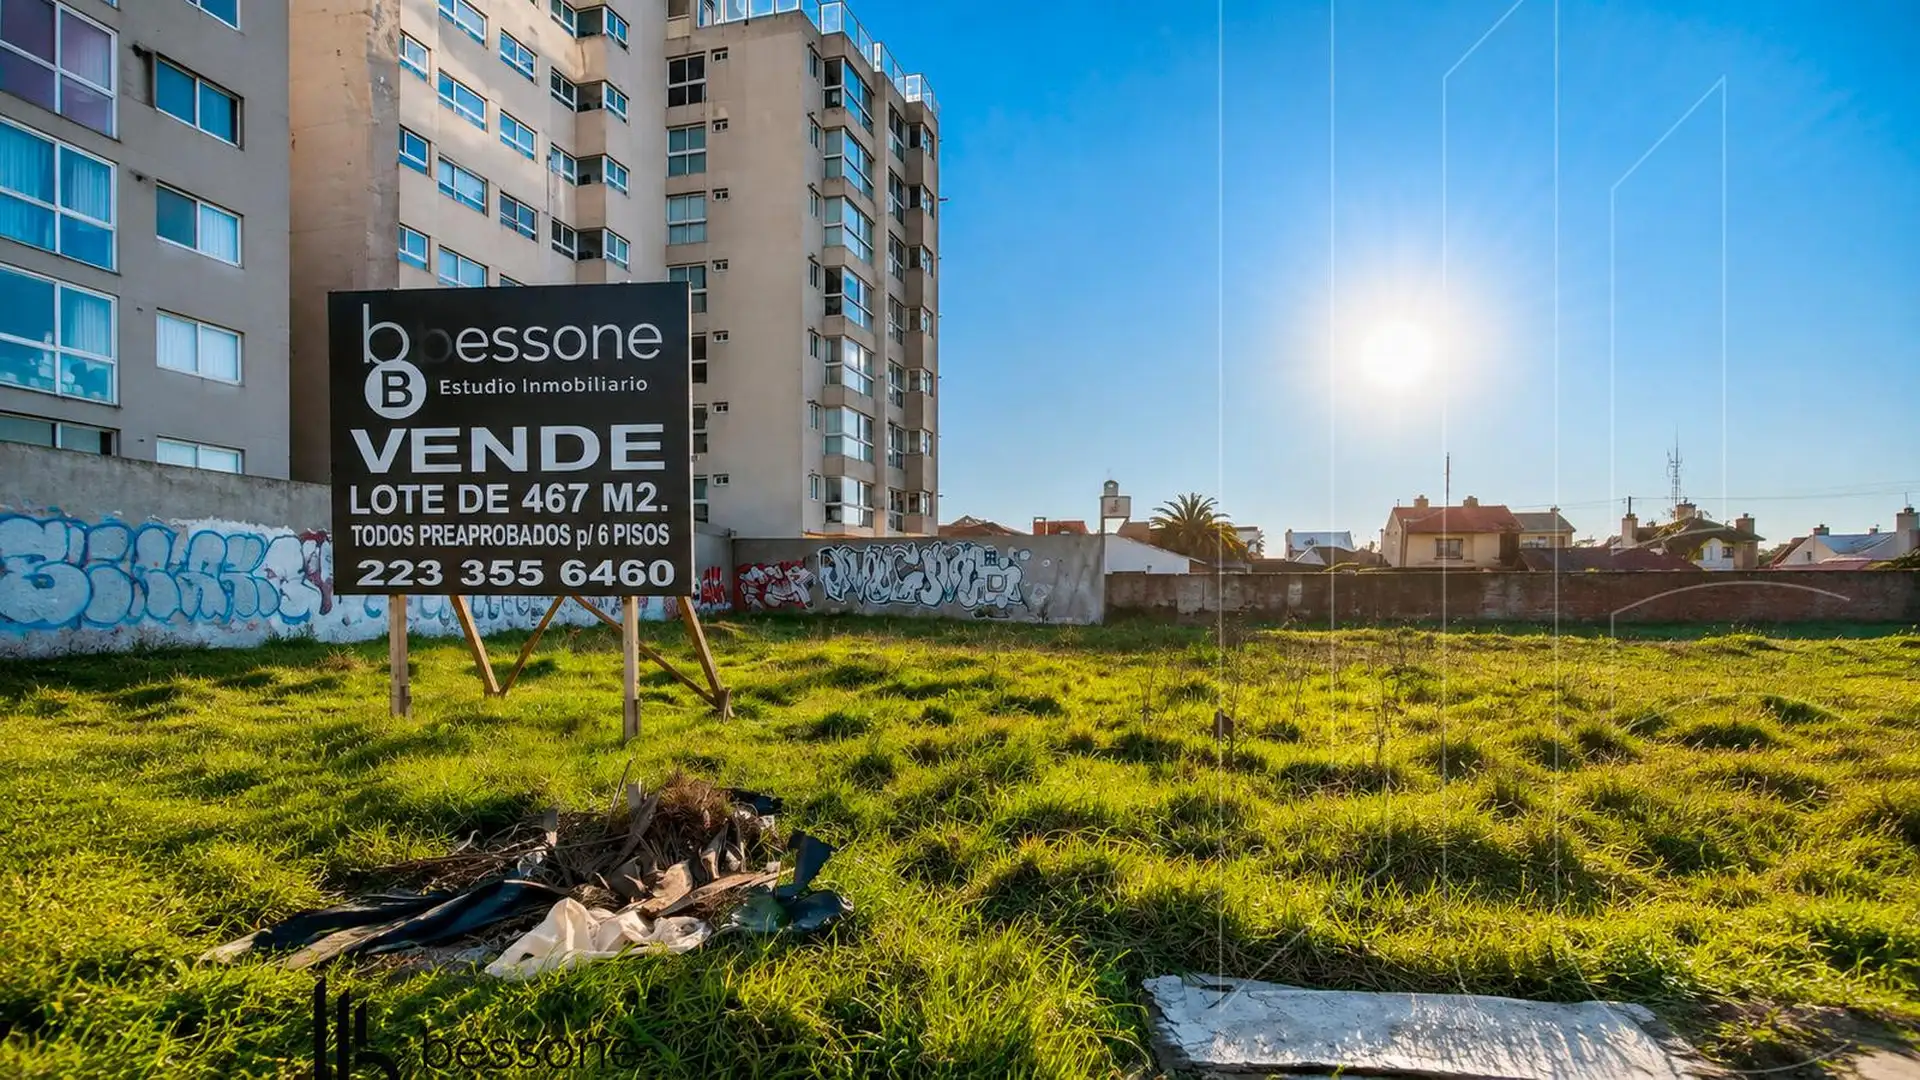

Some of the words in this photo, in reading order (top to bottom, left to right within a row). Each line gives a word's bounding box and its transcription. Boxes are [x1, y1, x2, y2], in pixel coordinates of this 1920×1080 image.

[381, 370, 413, 408] B
[439, 378, 516, 395] Estudio
[522, 376, 648, 394] Inmobiliario
[350, 424, 666, 474] VENDE
[350, 484, 446, 515] LOTE
[458, 484, 510, 514] DE
[521, 483, 589, 514] 467
[602, 482, 668, 513] M2.
[351, 524, 414, 548] TODOS
[419, 523, 571, 548] PREAPROBADOS
[576, 524, 593, 551] p/
[597, 524, 609, 546] 6
[613, 523, 670, 546] PISOS
[356, 559, 444, 587] 223
[460, 559, 544, 587] 355
[559, 559, 675, 587] 6460
